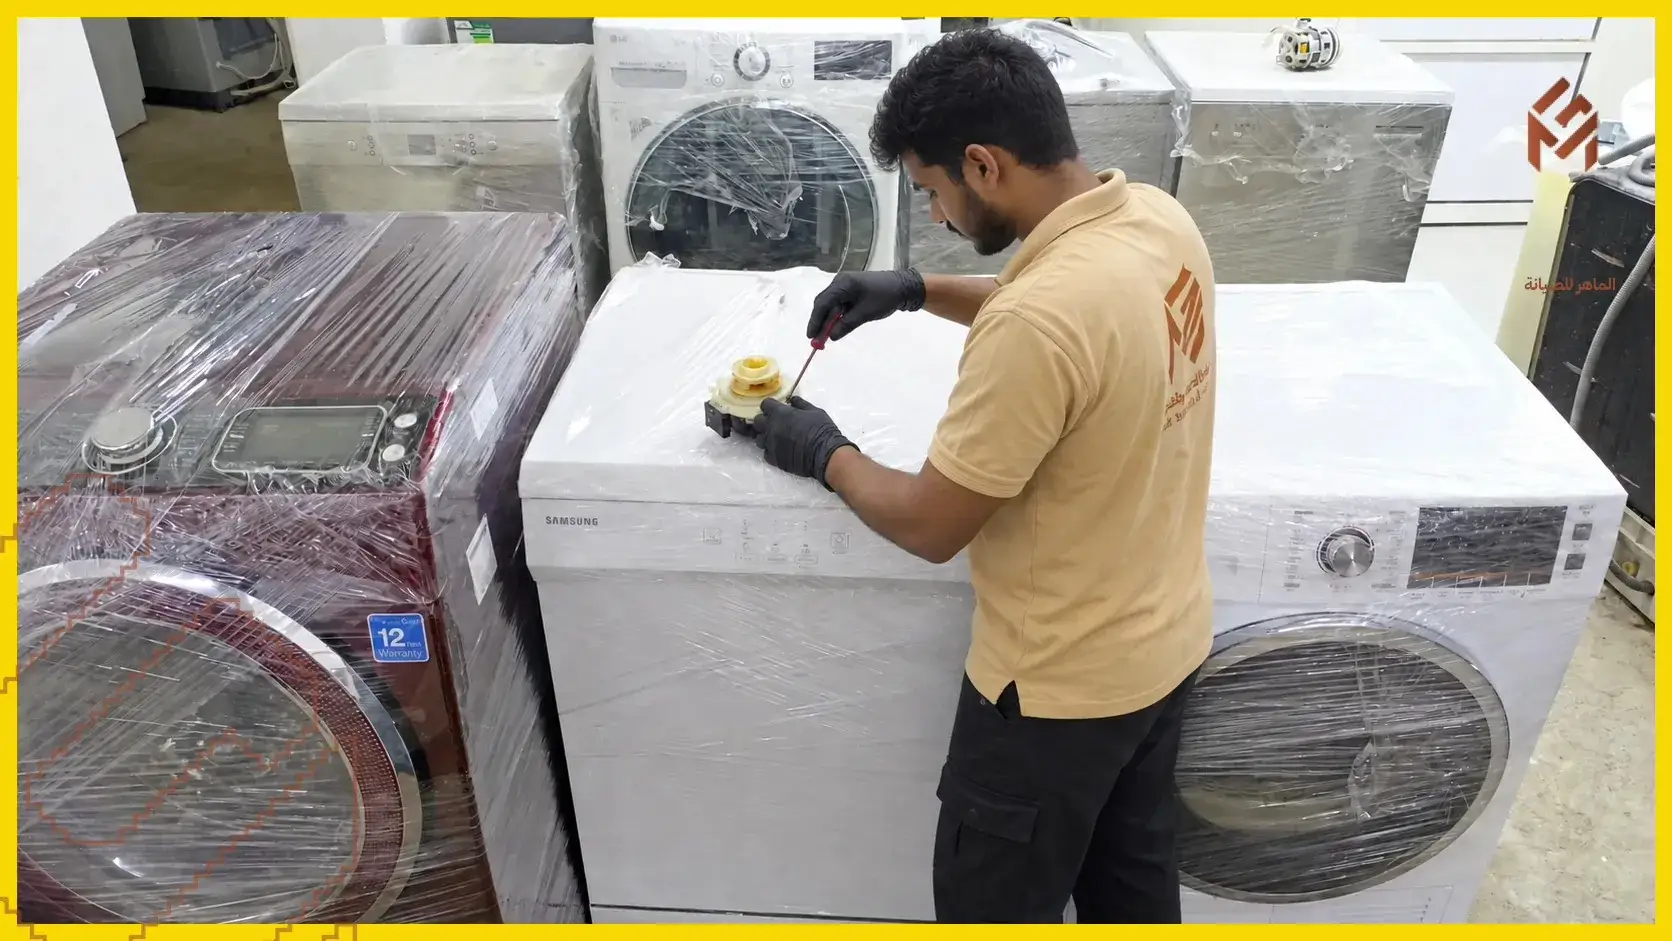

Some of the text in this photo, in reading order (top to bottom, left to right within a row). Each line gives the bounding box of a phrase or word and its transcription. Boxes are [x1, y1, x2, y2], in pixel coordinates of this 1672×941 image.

[545, 516, 599, 526] SAMSUNG
[377, 627, 406, 647] 12
[378, 648, 423, 659] Warranty
